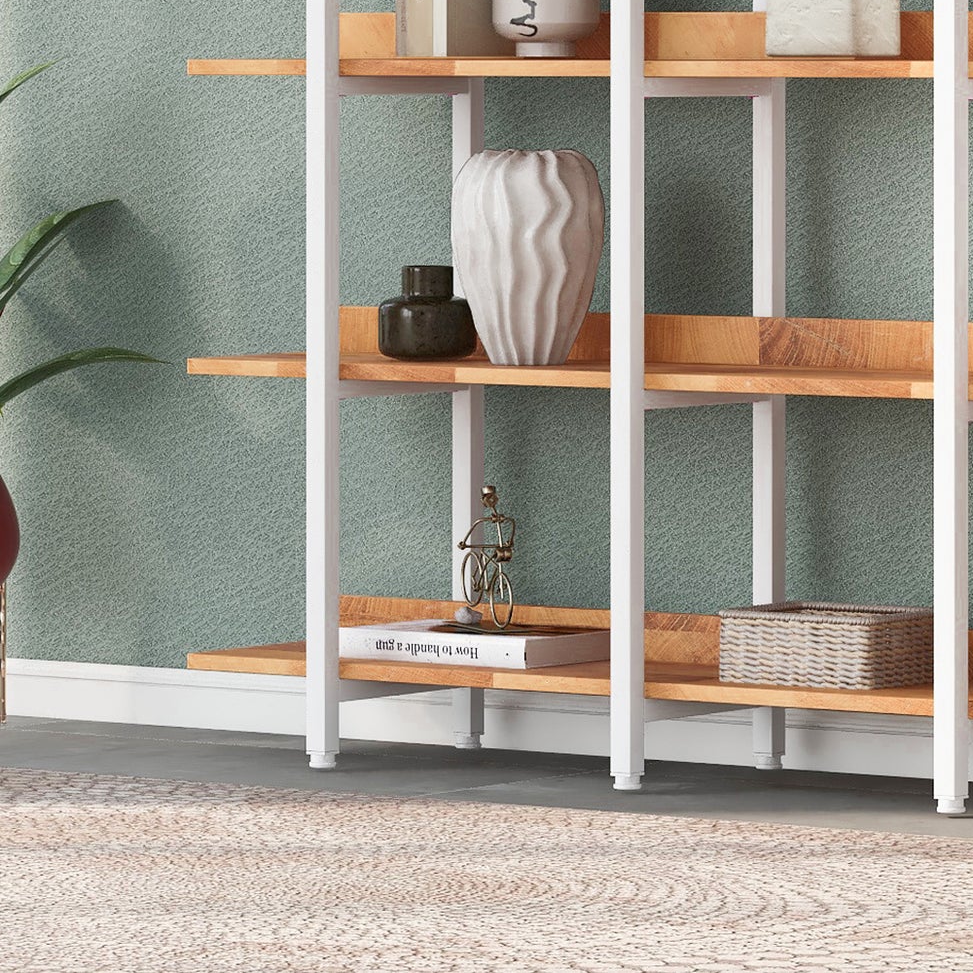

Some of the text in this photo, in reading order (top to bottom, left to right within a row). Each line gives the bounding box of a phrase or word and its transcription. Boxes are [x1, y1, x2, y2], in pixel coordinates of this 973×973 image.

[397, 642, 404, 652] a
[405, 643, 441, 657] handle
[442, 644, 453, 656] to
[455, 646, 479, 660] How
